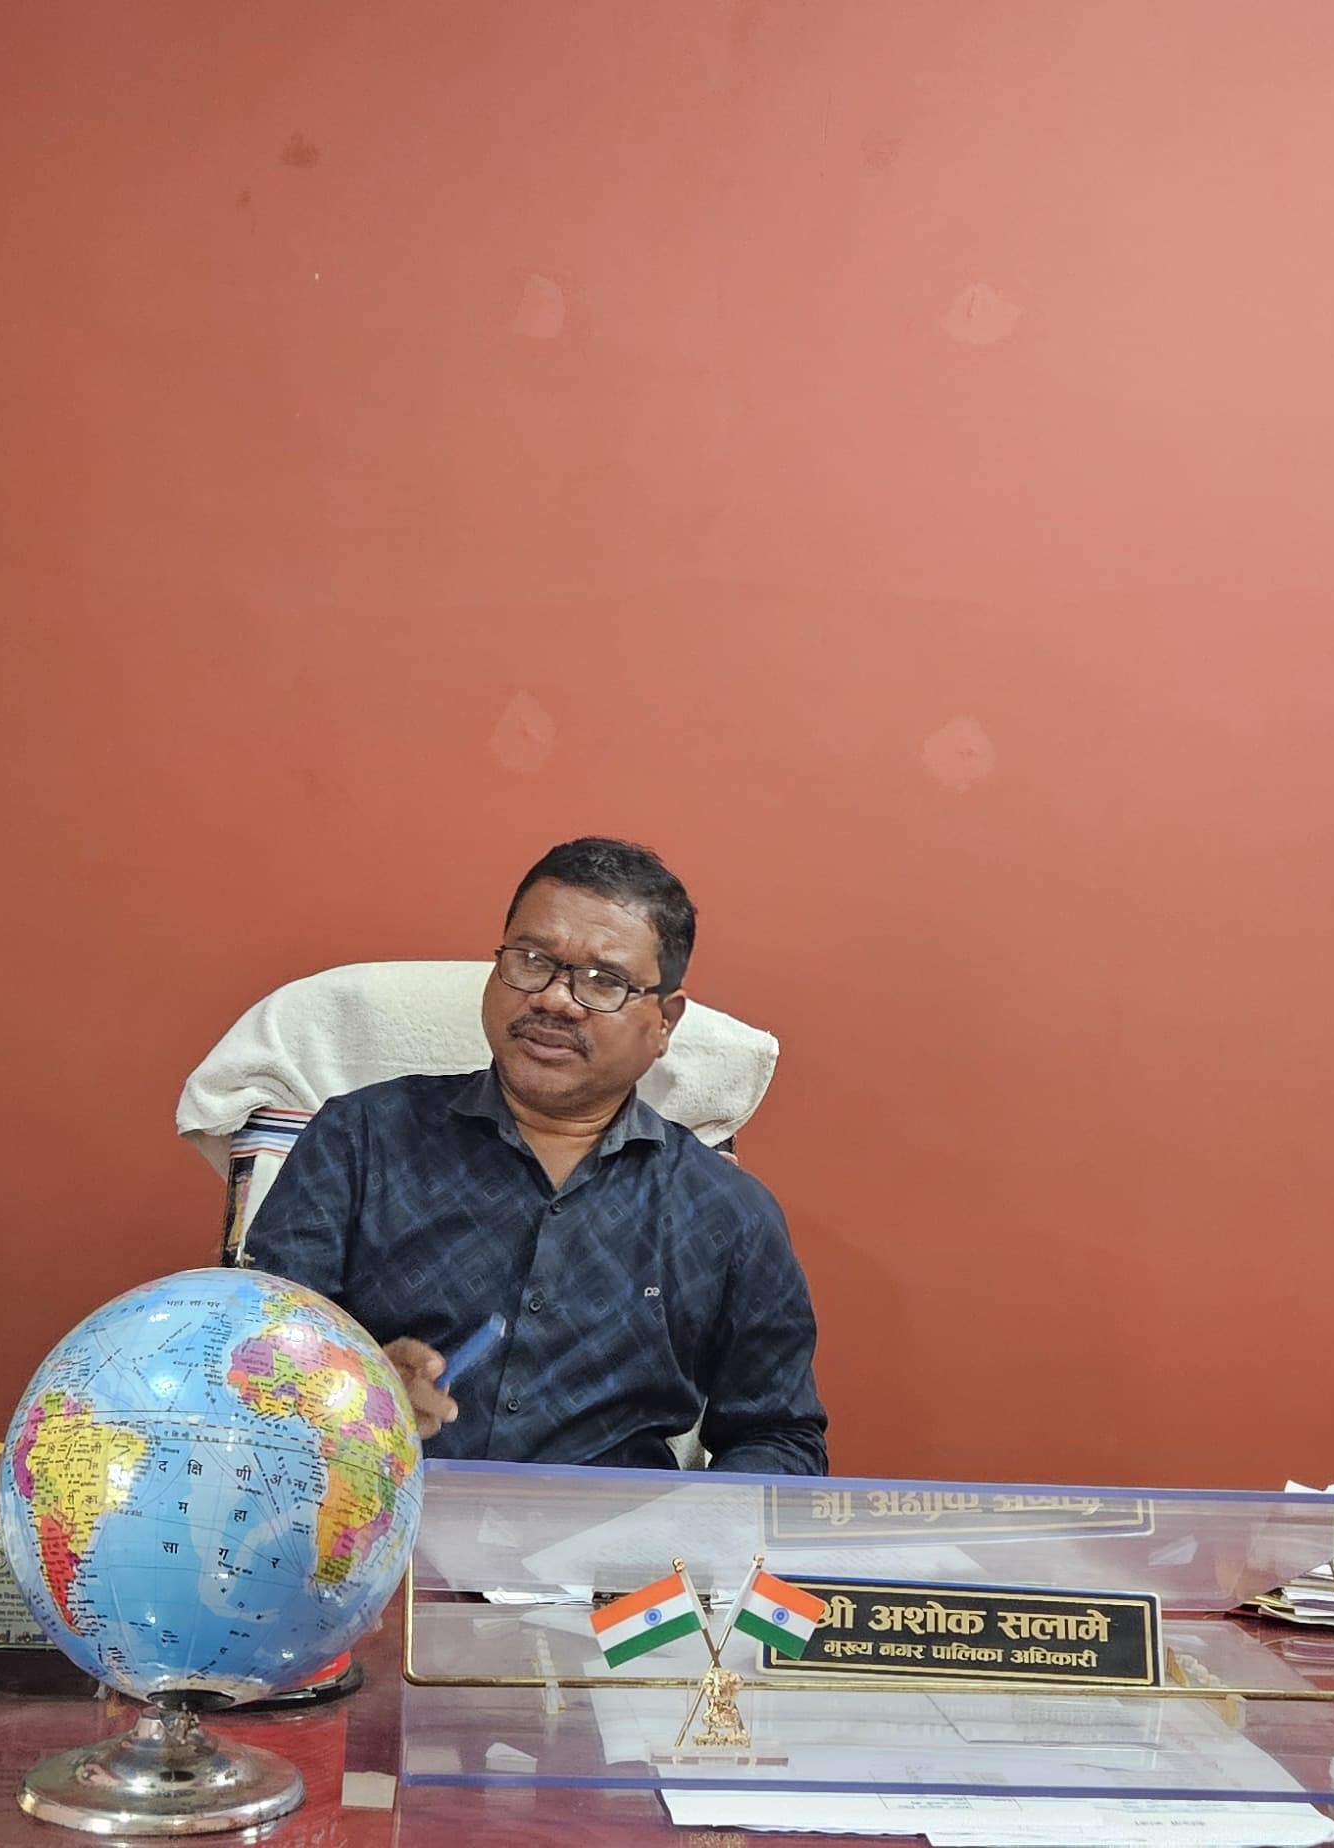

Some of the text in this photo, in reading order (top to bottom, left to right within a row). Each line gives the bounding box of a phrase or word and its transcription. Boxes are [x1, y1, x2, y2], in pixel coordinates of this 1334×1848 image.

[818, 1595, 1111, 1642] श्री अशोक सलामे
[824, 1639, 1098, 1669] मुख्य नगर पालिका अधिकारी
